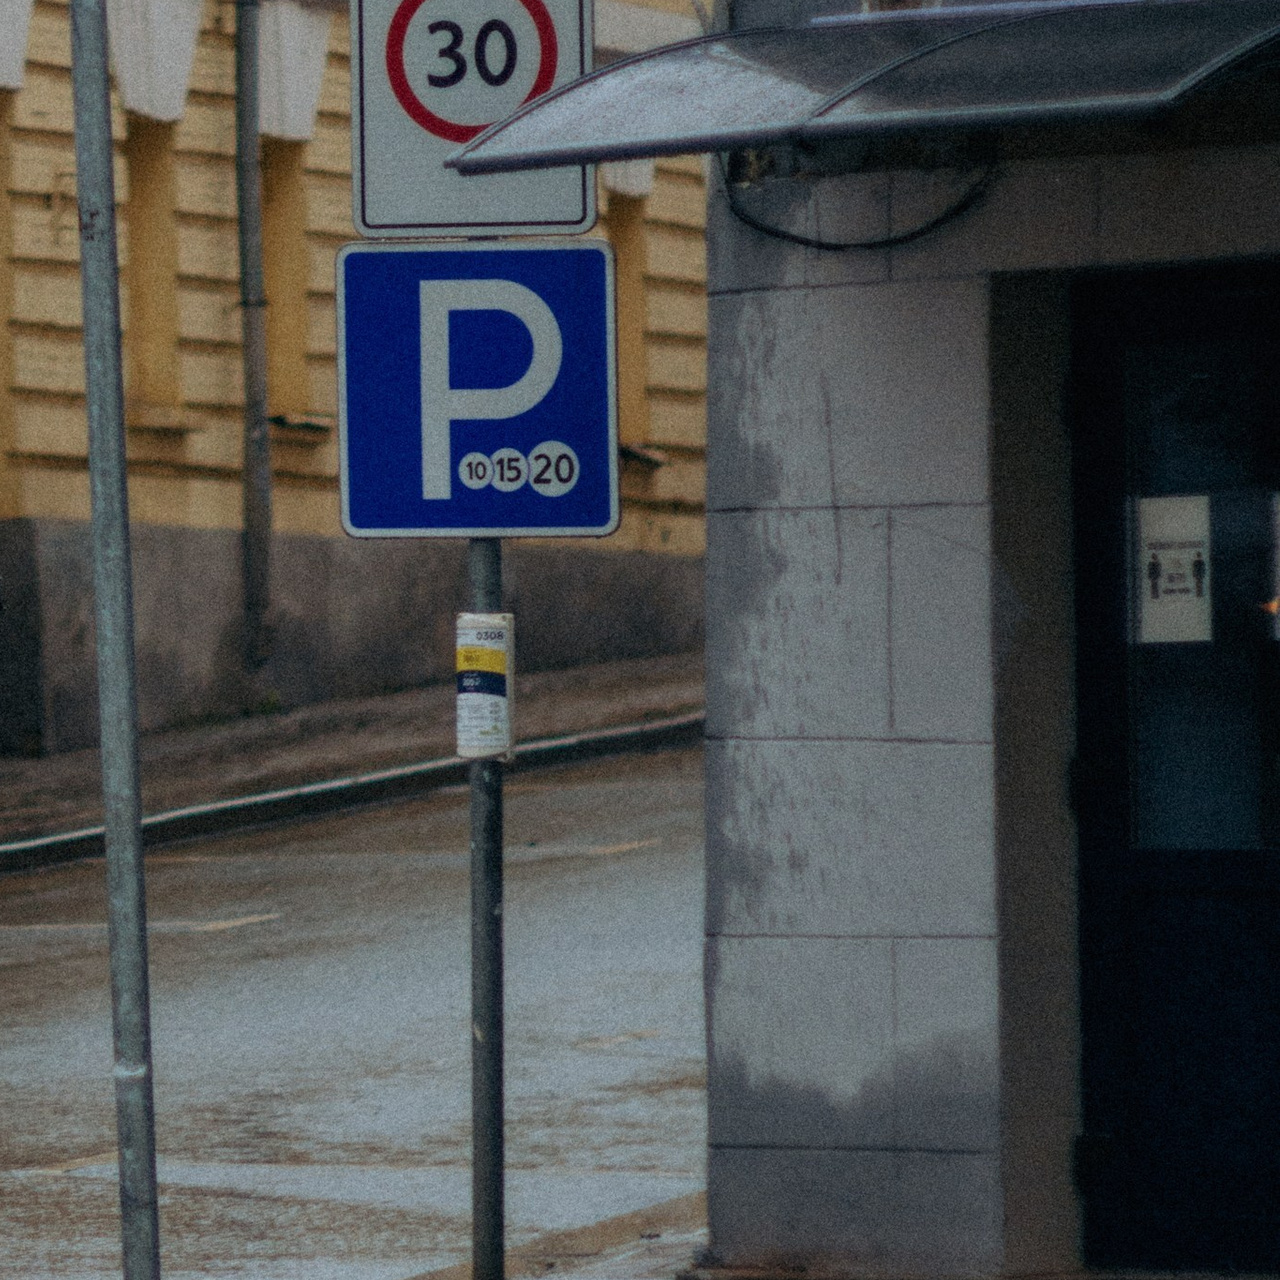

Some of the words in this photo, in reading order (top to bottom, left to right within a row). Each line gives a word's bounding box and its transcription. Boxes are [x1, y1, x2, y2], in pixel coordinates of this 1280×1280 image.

[426, 19, 518, 88] 30
[420, 278, 563, 500] P
[466, 461, 487, 480] 10
[496, 457, 522, 482] 15
[533, 453, 575, 484] 20
